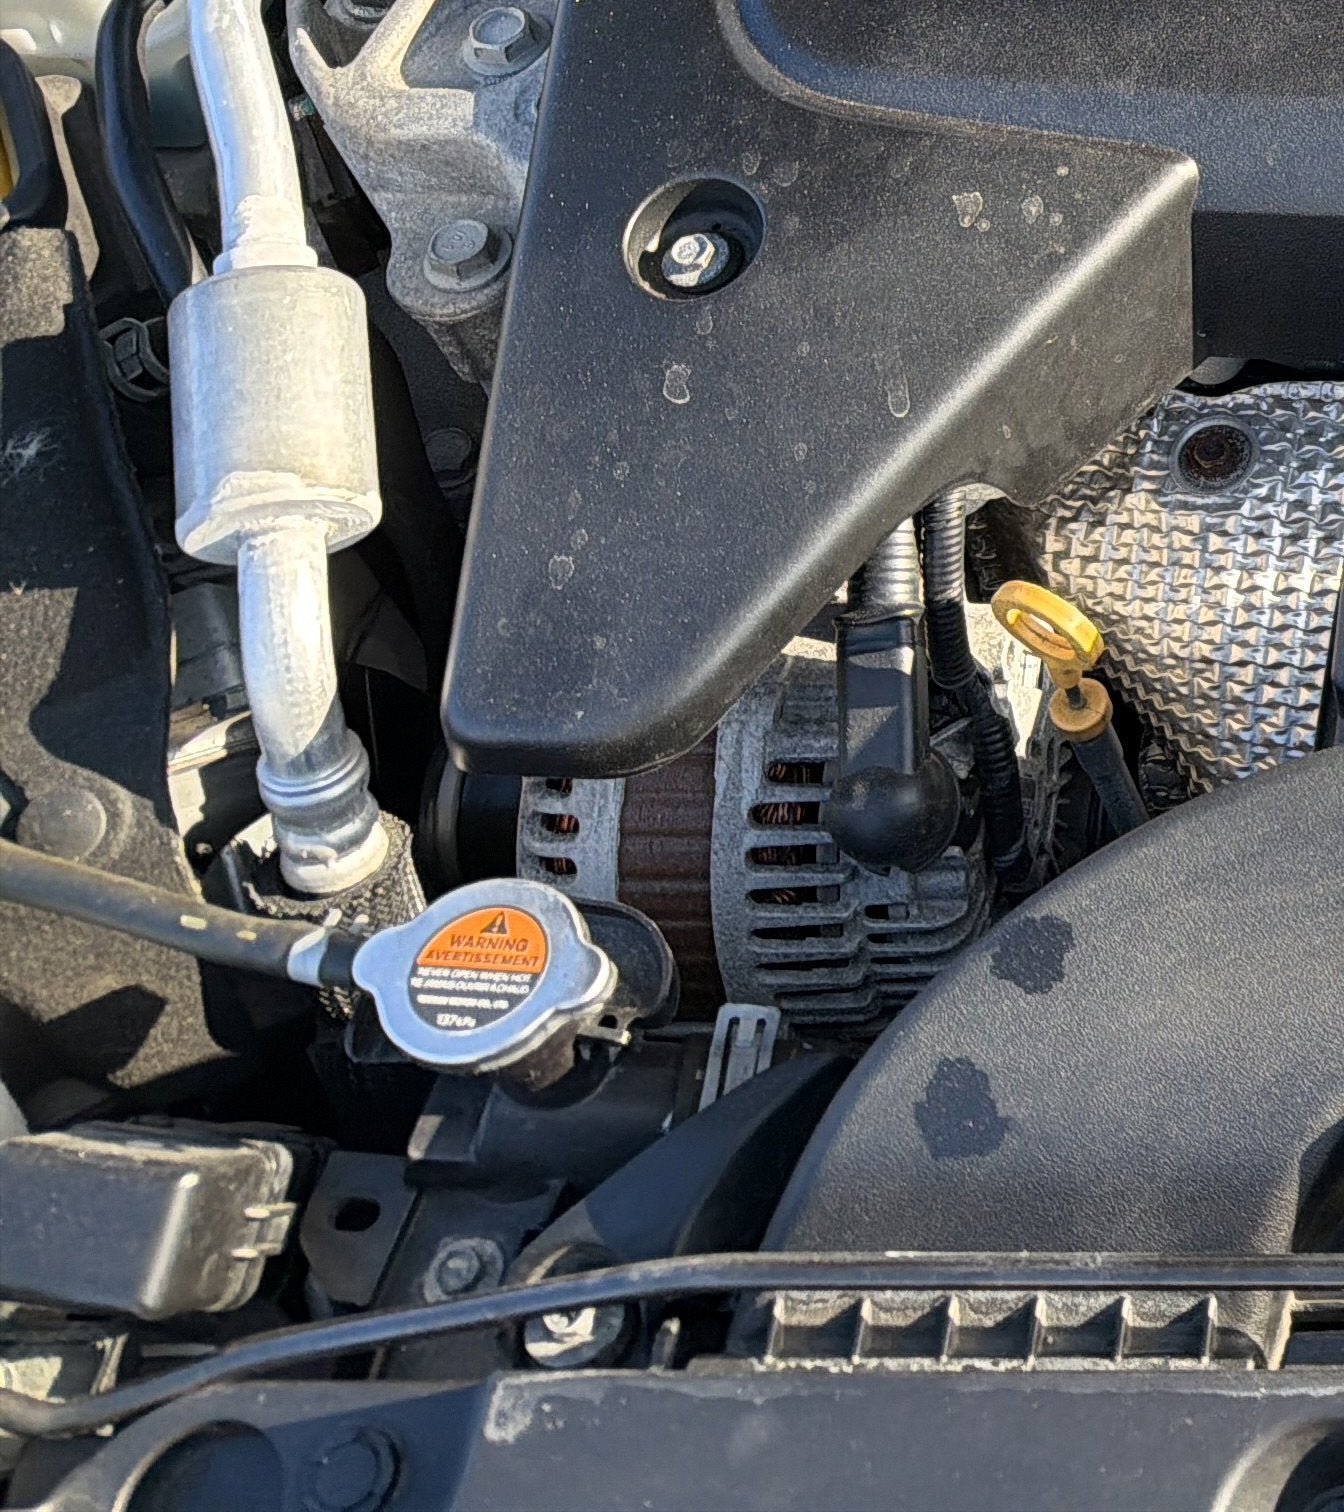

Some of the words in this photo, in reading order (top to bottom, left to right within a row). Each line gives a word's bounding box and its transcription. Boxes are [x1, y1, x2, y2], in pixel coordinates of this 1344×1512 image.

[449, 934, 529, 951] WARNING
[425, 949, 540, 968] AVERTISSEMENT
[451, 969, 478, 979] OPEN
[479, 971, 509, 981] WHEN
